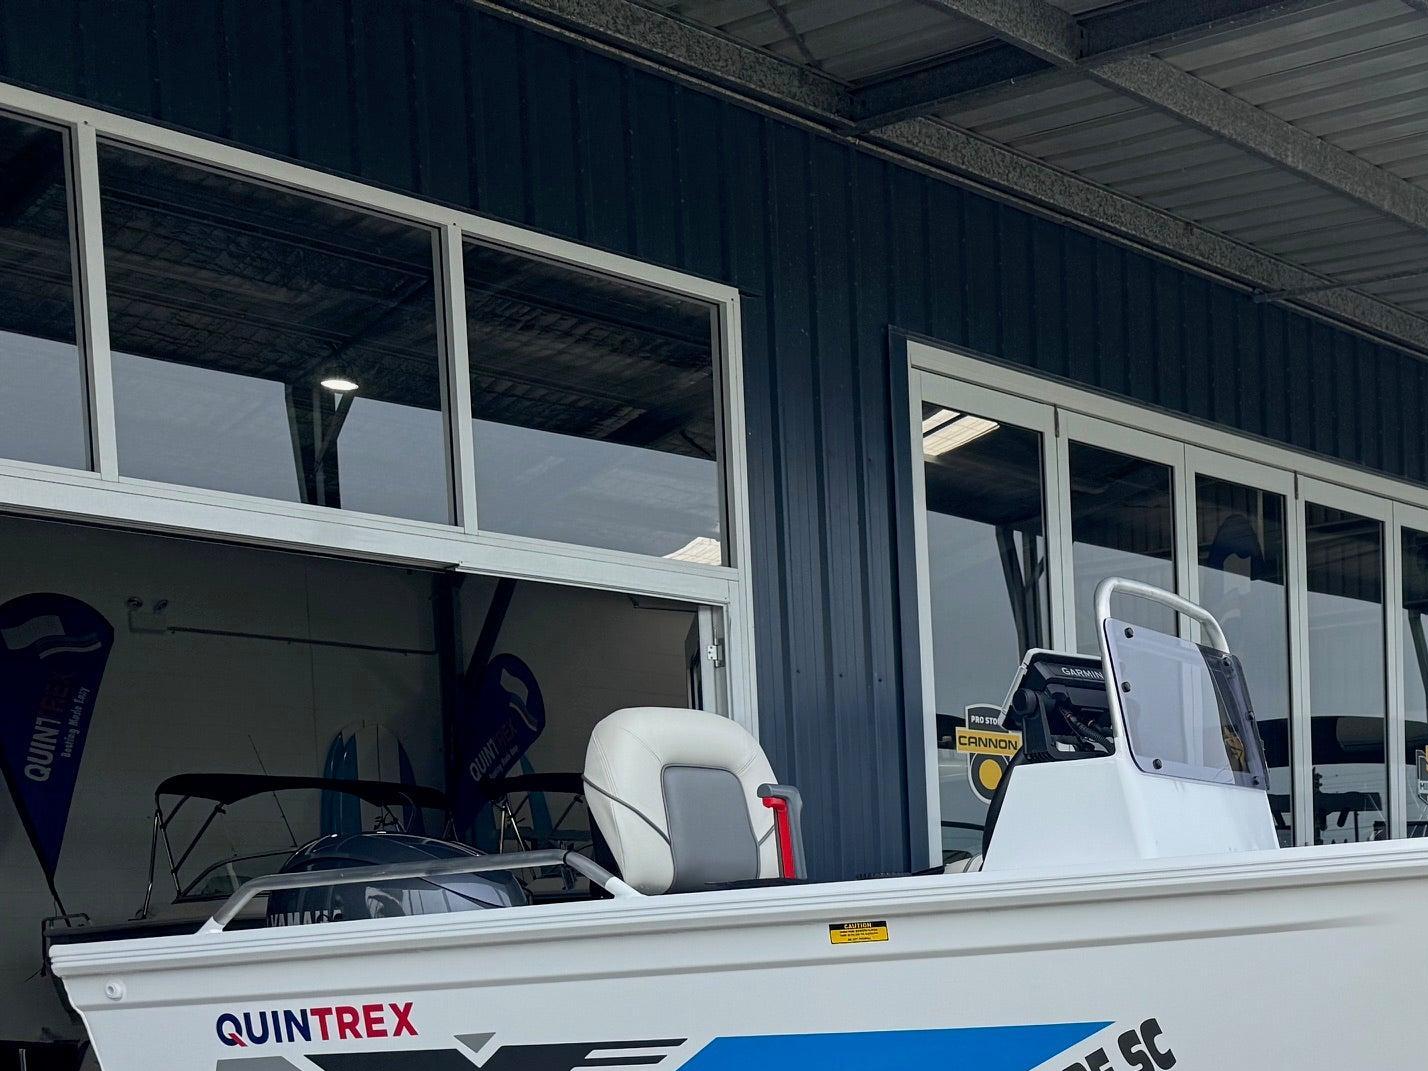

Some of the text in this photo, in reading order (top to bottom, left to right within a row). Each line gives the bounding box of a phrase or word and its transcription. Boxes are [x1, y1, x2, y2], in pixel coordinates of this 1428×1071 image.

[1061, 667, 1104, 680] GARMIN
[970, 715, 1001, 726] PRO STO
[958, 735, 1018, 750] CANNON
[216, 1002, 418, 1047] QUINTREX
